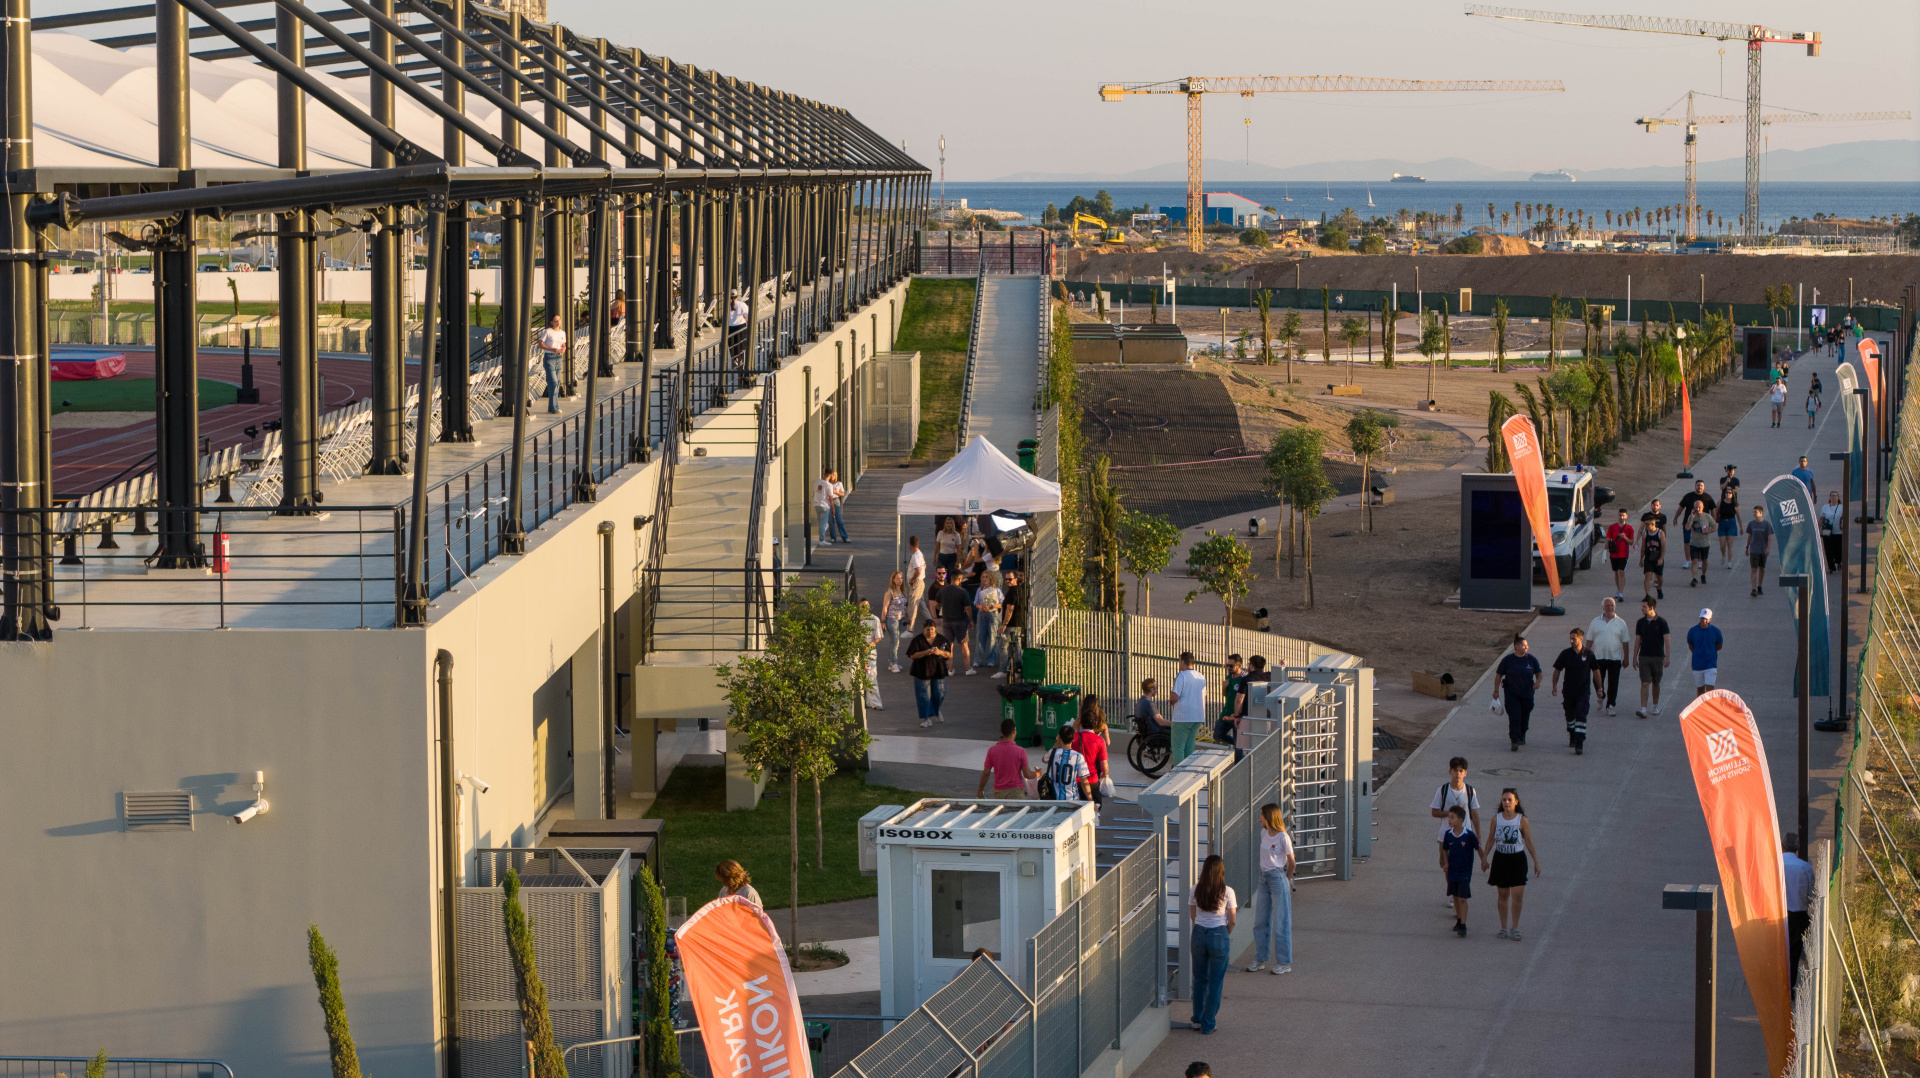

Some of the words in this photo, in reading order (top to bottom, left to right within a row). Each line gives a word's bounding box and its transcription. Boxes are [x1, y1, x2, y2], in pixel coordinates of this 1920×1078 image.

[1055, 761, 1073, 785] 10
[879, 828, 953, 840] ISOBOX
[1011, 832, 1053, 840] 6108880
